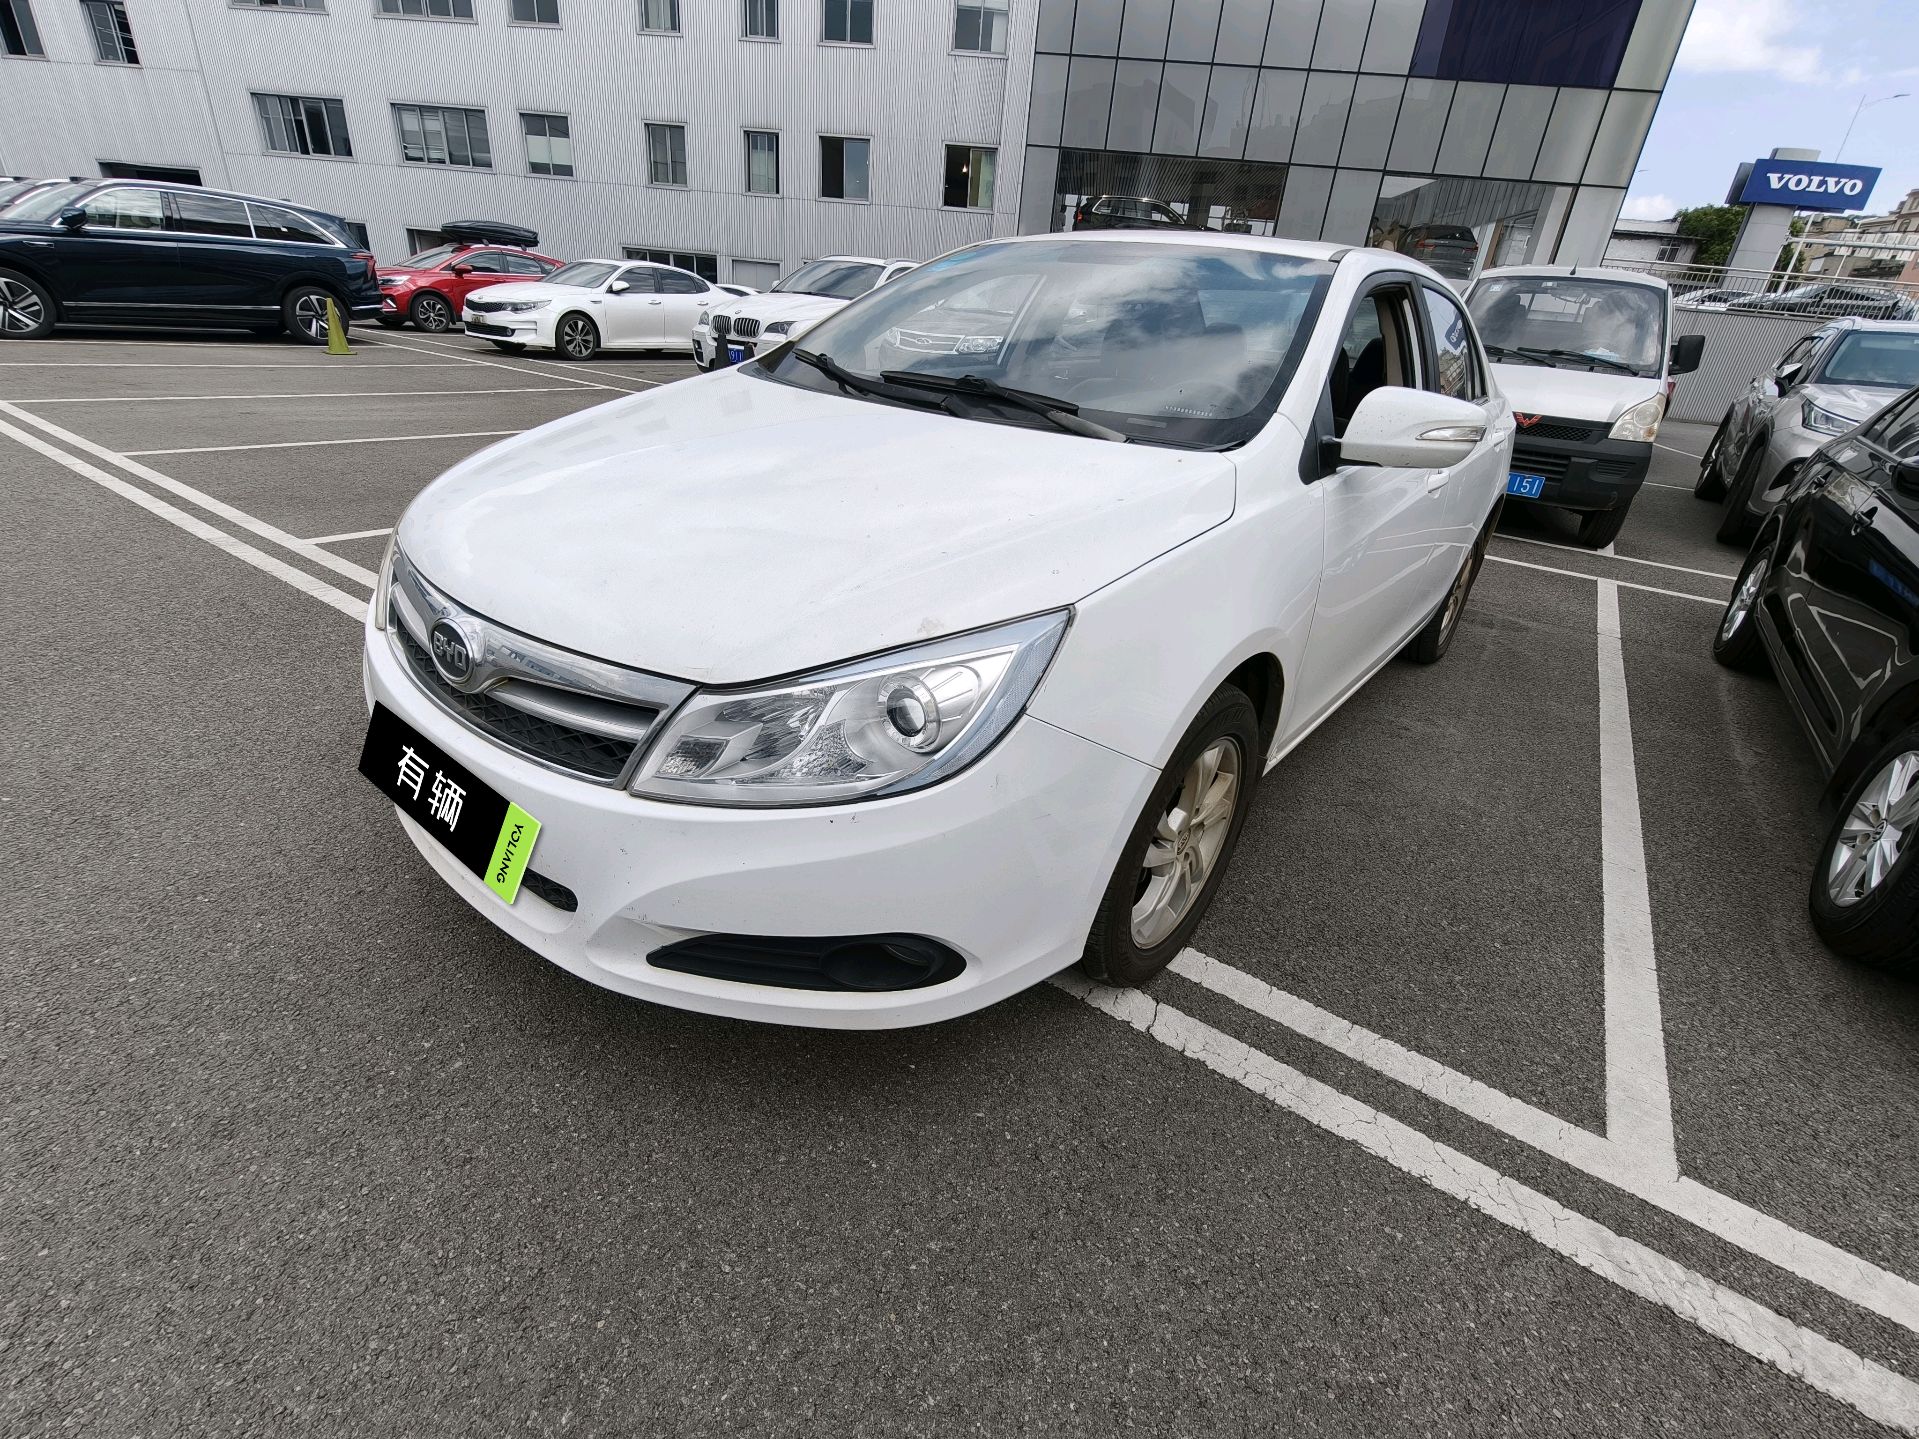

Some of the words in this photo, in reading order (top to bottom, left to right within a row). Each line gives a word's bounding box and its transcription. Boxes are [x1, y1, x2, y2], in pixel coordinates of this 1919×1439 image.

[1766, 172, 1863, 196] VOLVO
[1507, 475, 1540, 494] 151
[433, 631, 467, 671] BYD
